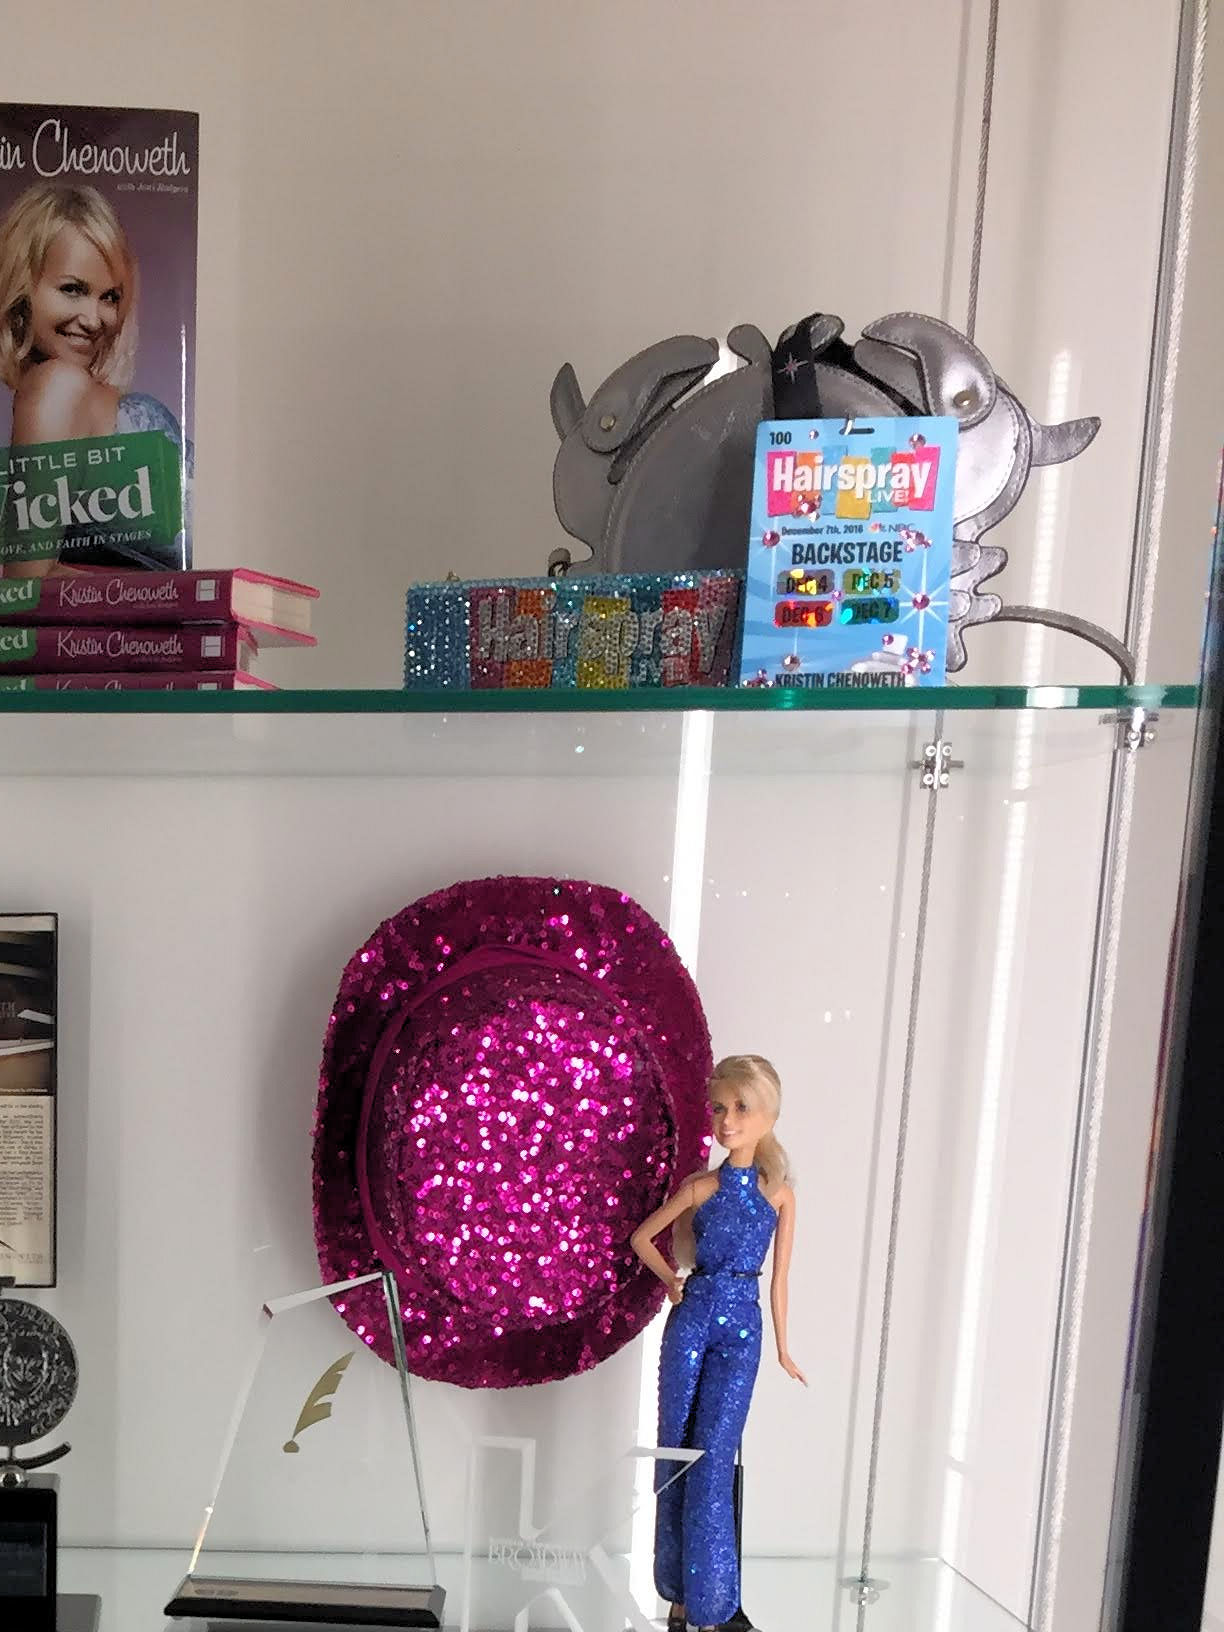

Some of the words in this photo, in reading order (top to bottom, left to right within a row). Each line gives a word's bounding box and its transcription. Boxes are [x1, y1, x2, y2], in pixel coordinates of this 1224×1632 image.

[33, 119, 190, 177] Chenoweth
[769, 431, 792, 446] 100
[87, 446, 128, 465] BIT
[772, 454, 933, 499] Hairspray
[868, 489, 909, 504] LIVE!
[29, 539, 53, 553] AND
[56, 535, 90, 550] FAITH
[92, 533, 106, 547] IN
[109, 528, 153, 544] STAGES
[781, 525, 823, 537] December
[791, 541, 904, 566] BACKSTAGE
[59, 579, 103, 607] Kristin
[105, 578, 179, 606] Chenoweth
[57, 630, 104, 659] Kristin
[106, 631, 183, 658] Chenoweth
[477, 595, 727, 675] Hairspray
[775, 673, 824, 688] KRISTIN
[828, 671, 906, 688] CHENOWETH
